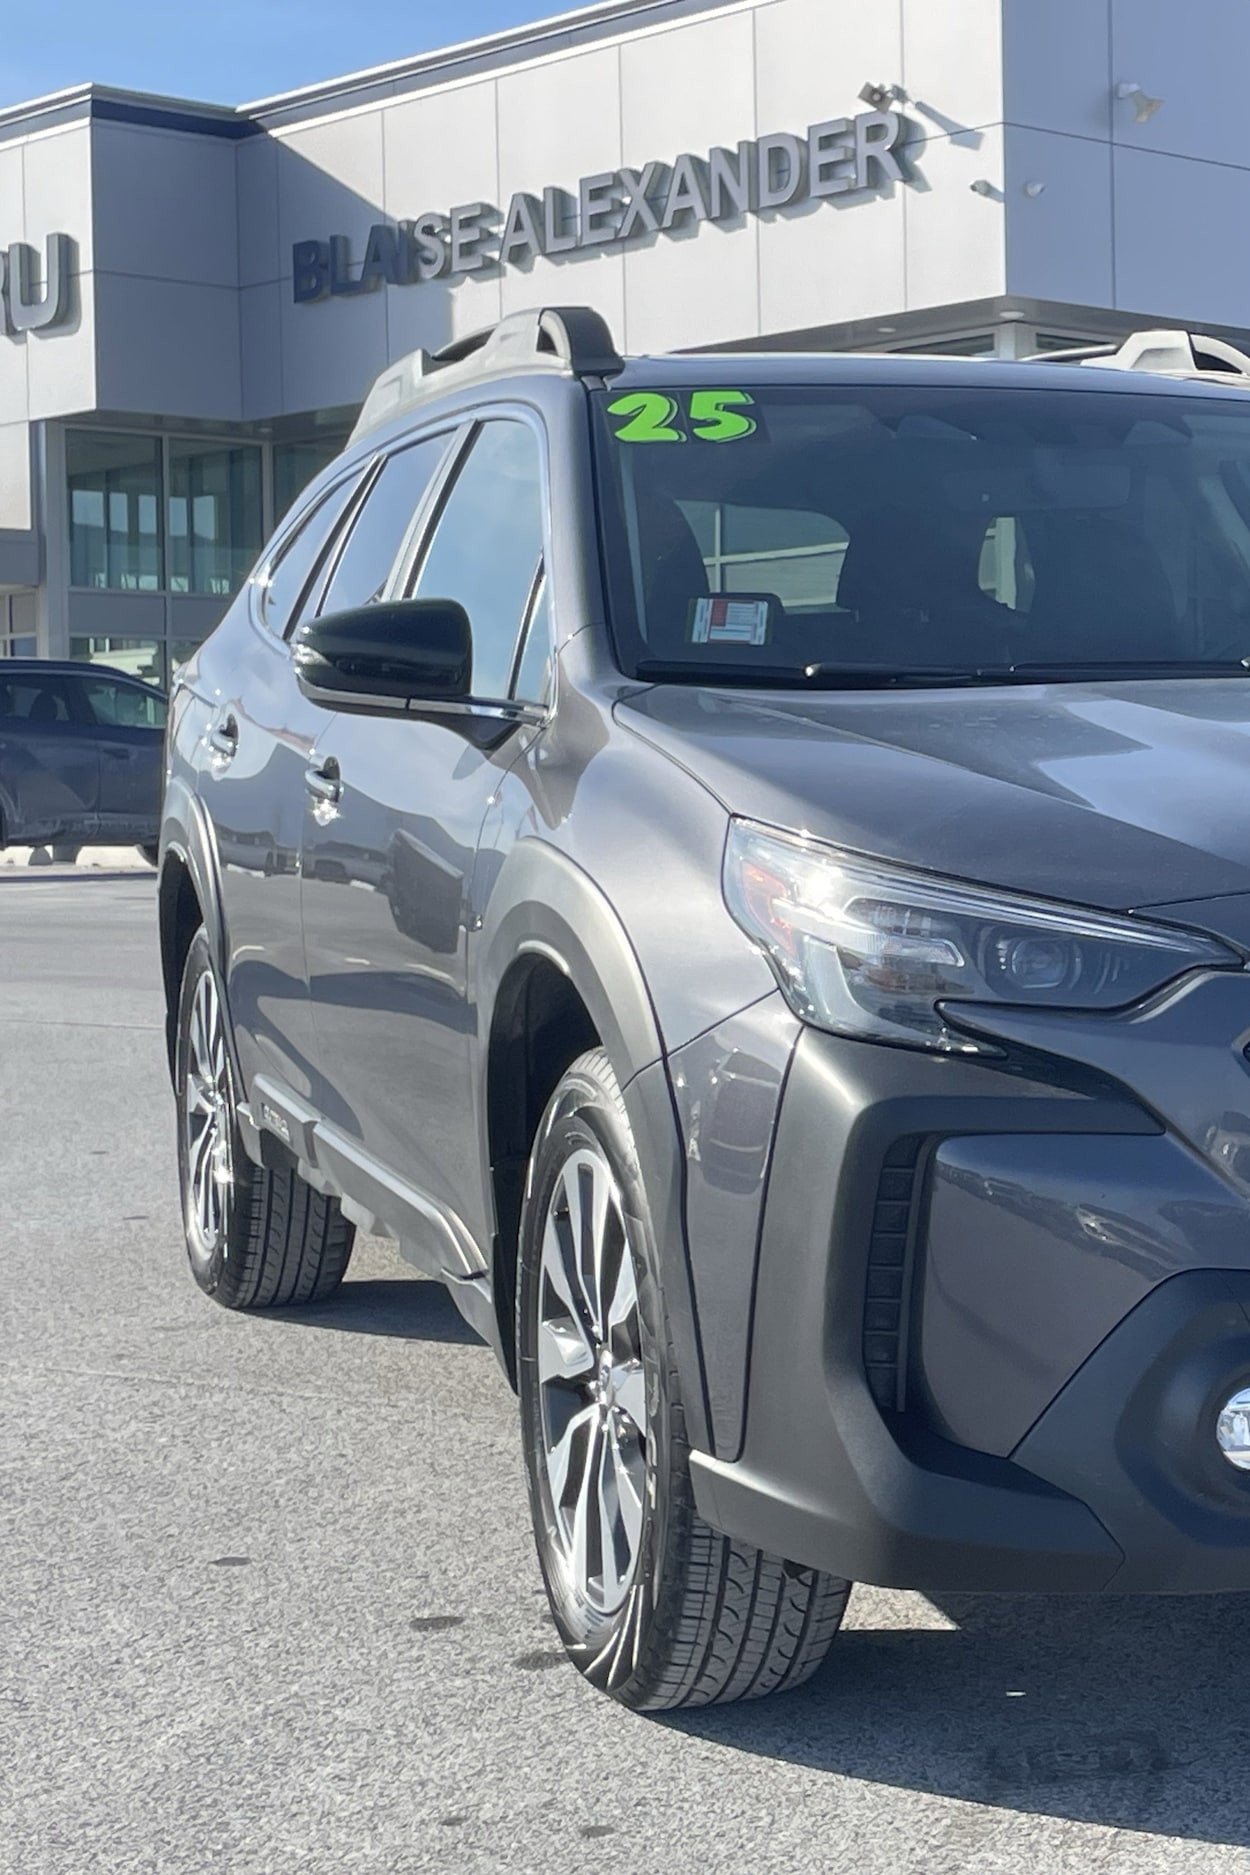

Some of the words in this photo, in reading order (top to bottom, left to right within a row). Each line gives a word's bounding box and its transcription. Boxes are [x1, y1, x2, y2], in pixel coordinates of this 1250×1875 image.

[292, 203, 490, 303] BLAISE
[500, 110, 906, 264] ALEXANDER
[0, 231, 74, 341] U
[607, 390, 757, 443] 25
